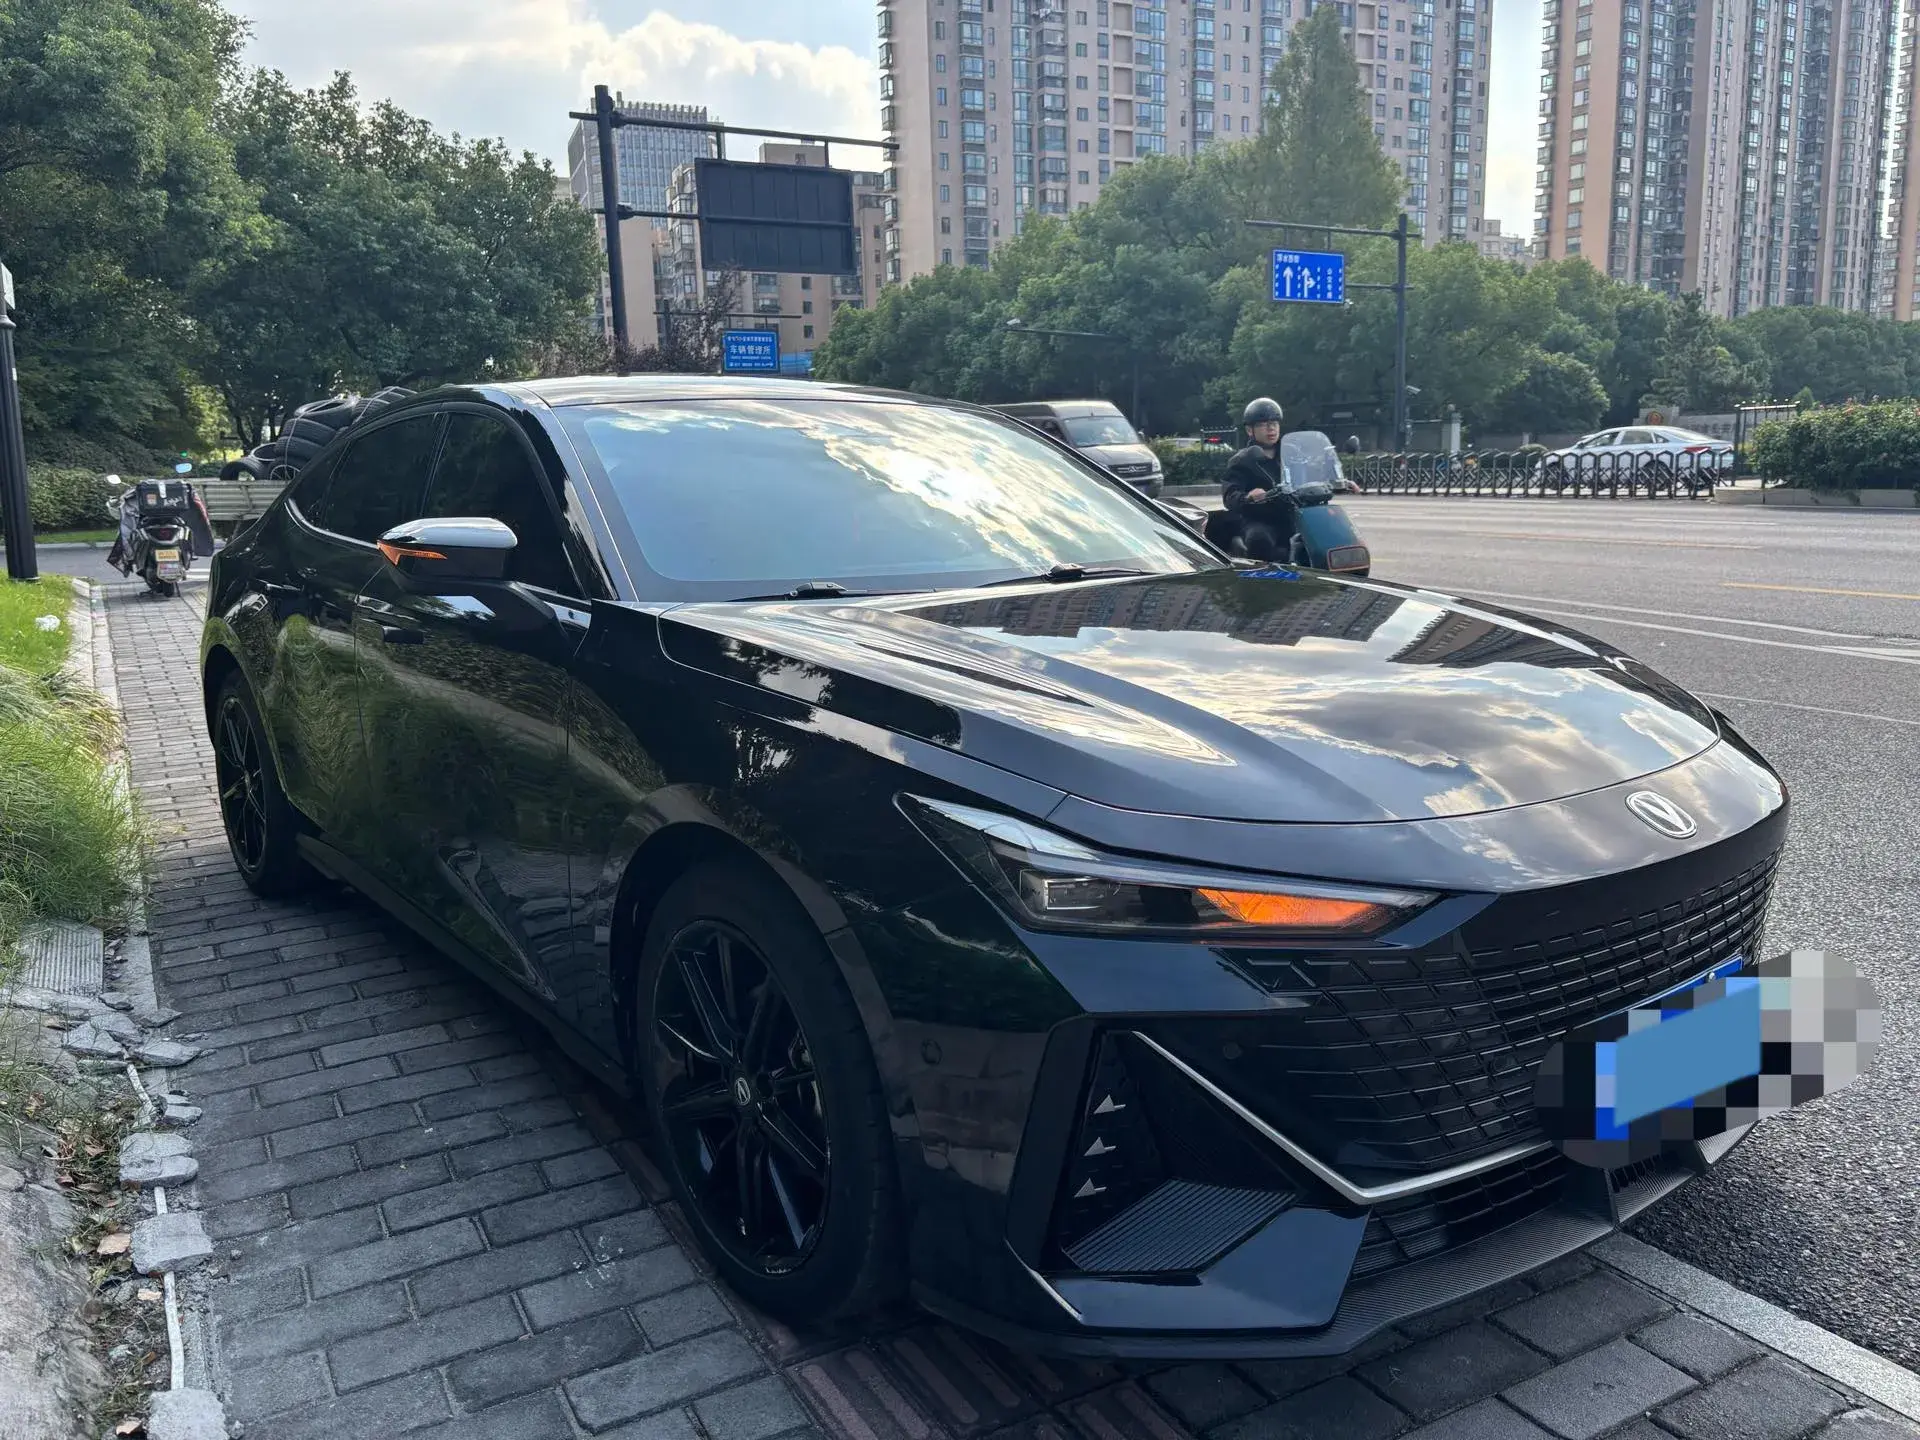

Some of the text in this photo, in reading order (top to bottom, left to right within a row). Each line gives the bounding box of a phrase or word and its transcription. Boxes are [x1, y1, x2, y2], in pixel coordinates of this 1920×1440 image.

[730, 345, 770, 355] 车辆管理所
